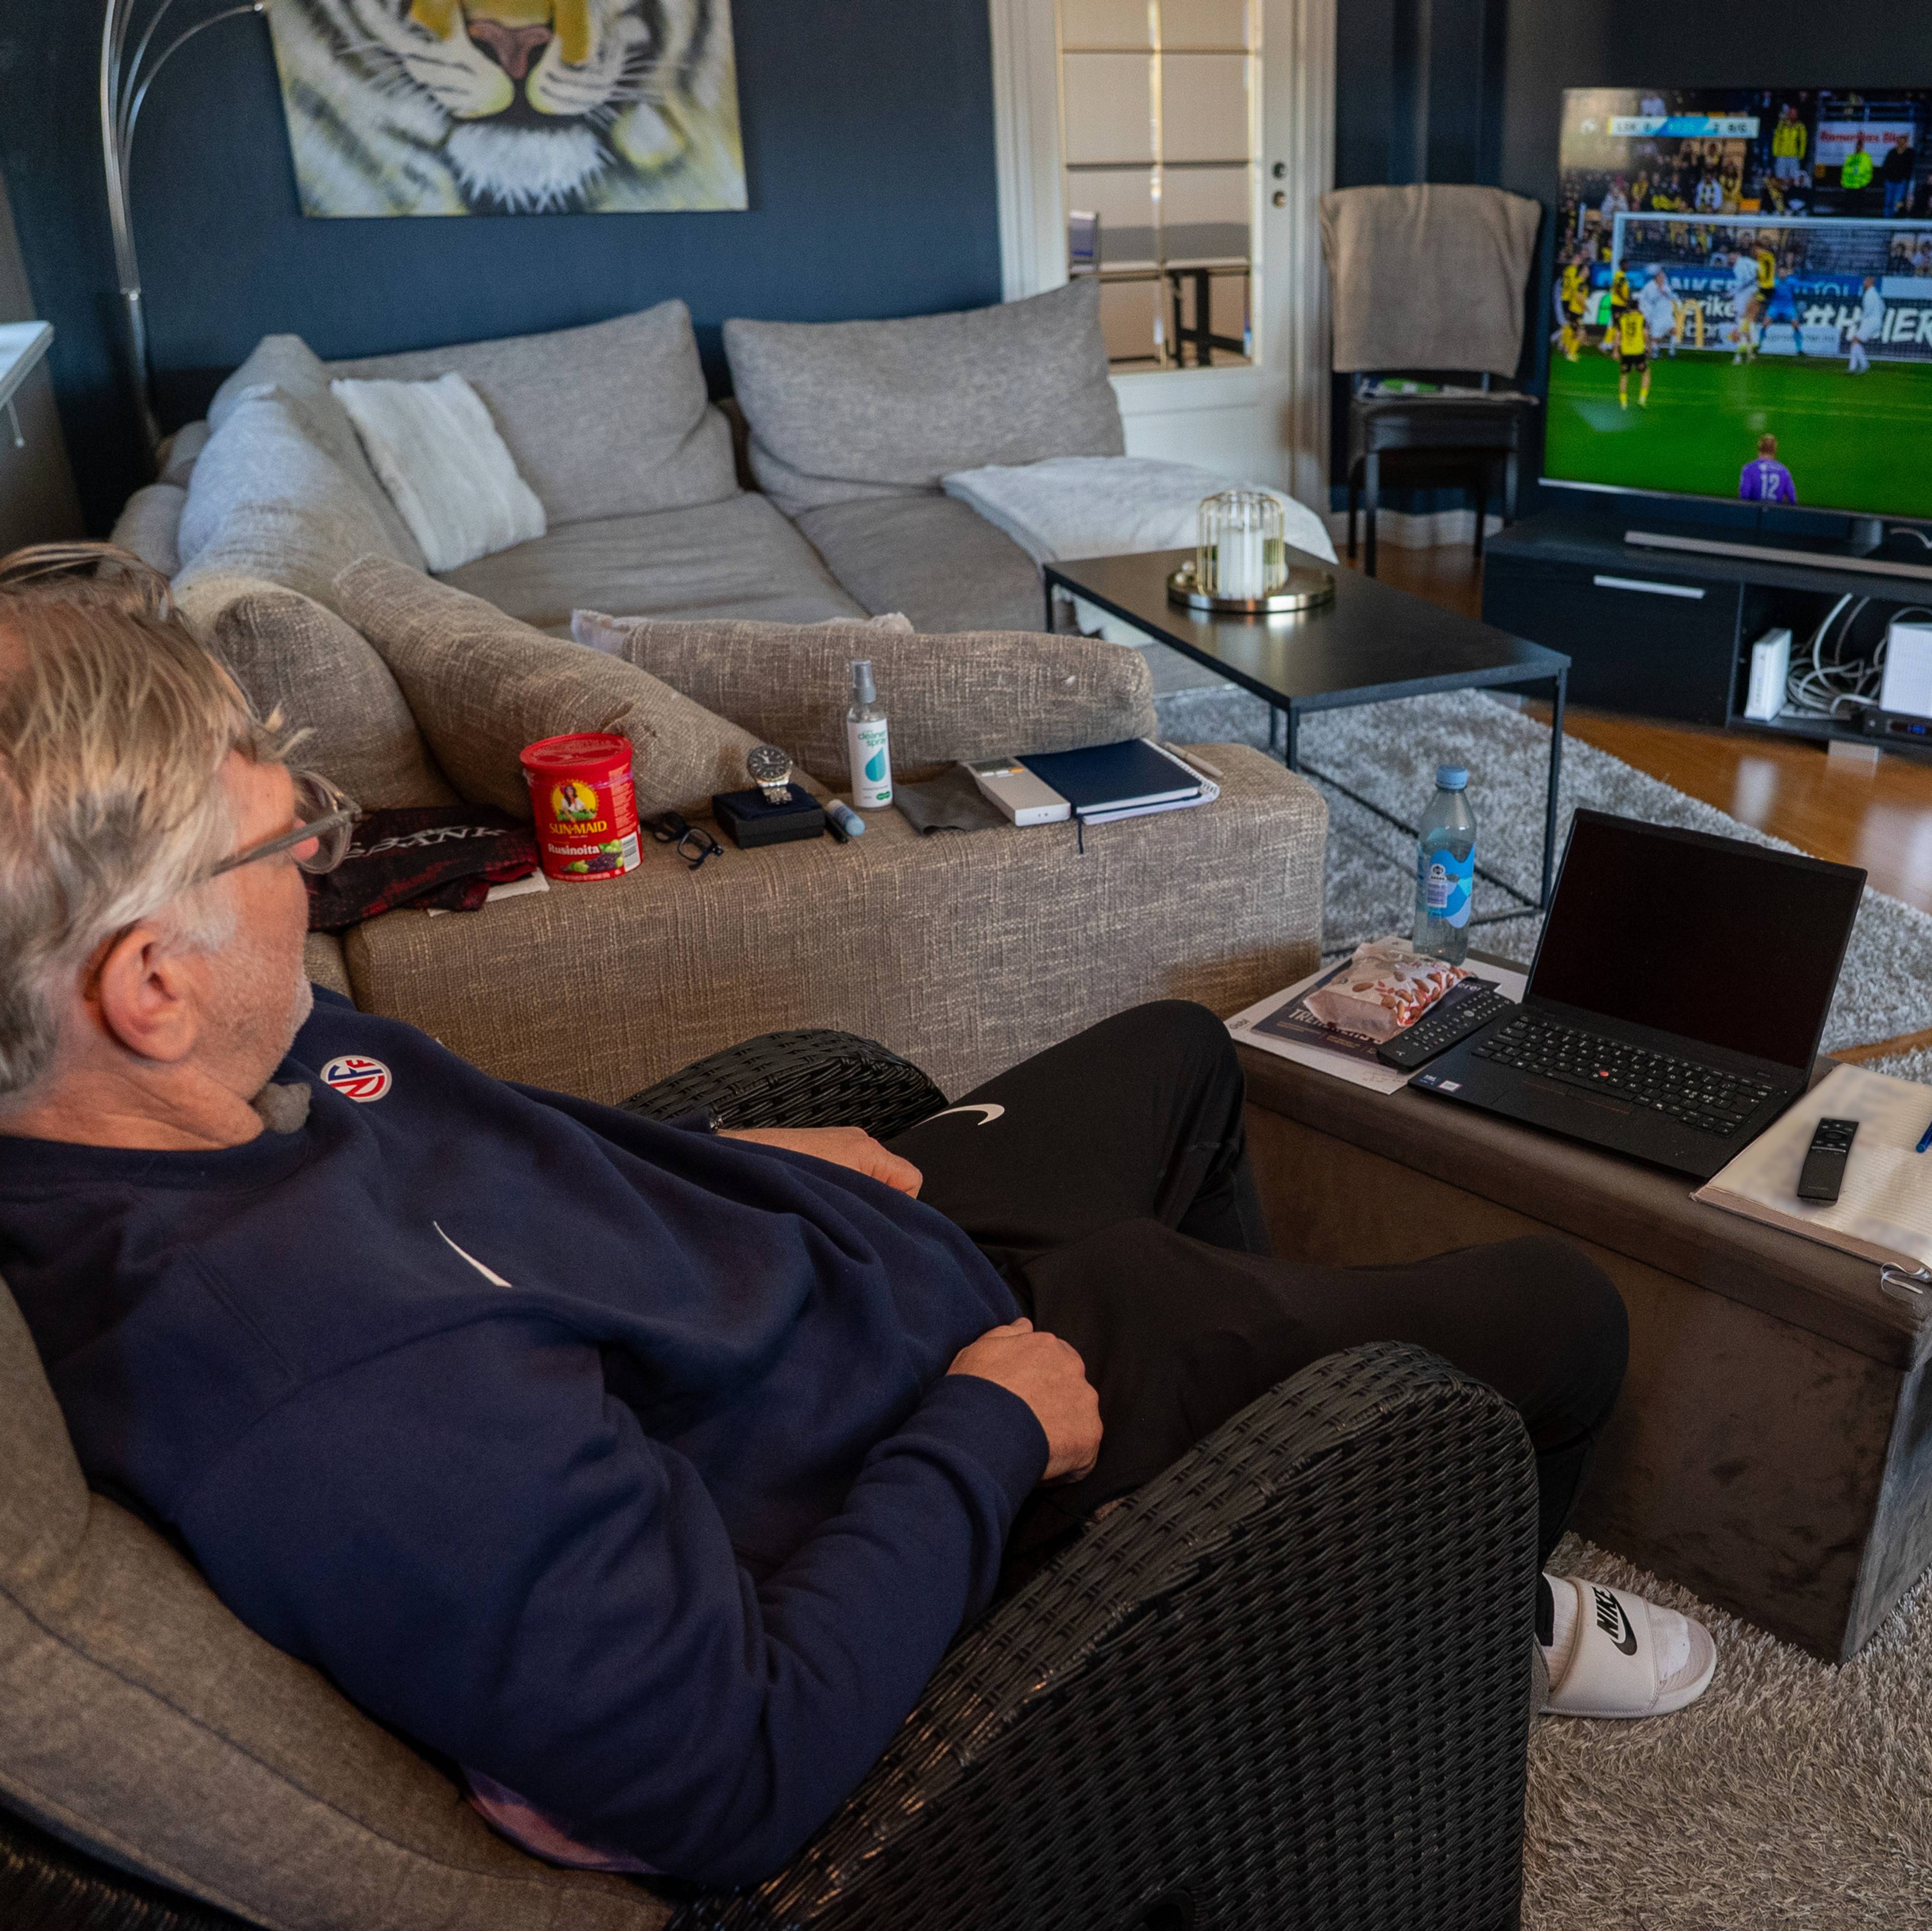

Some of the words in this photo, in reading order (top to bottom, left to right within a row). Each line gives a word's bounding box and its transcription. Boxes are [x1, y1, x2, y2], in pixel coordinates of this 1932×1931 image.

[1760, 473, 1780, 500] 12
[548, 843, 600, 856] Rusinoita
[1591, 1586, 1619, 1640] NIKE
